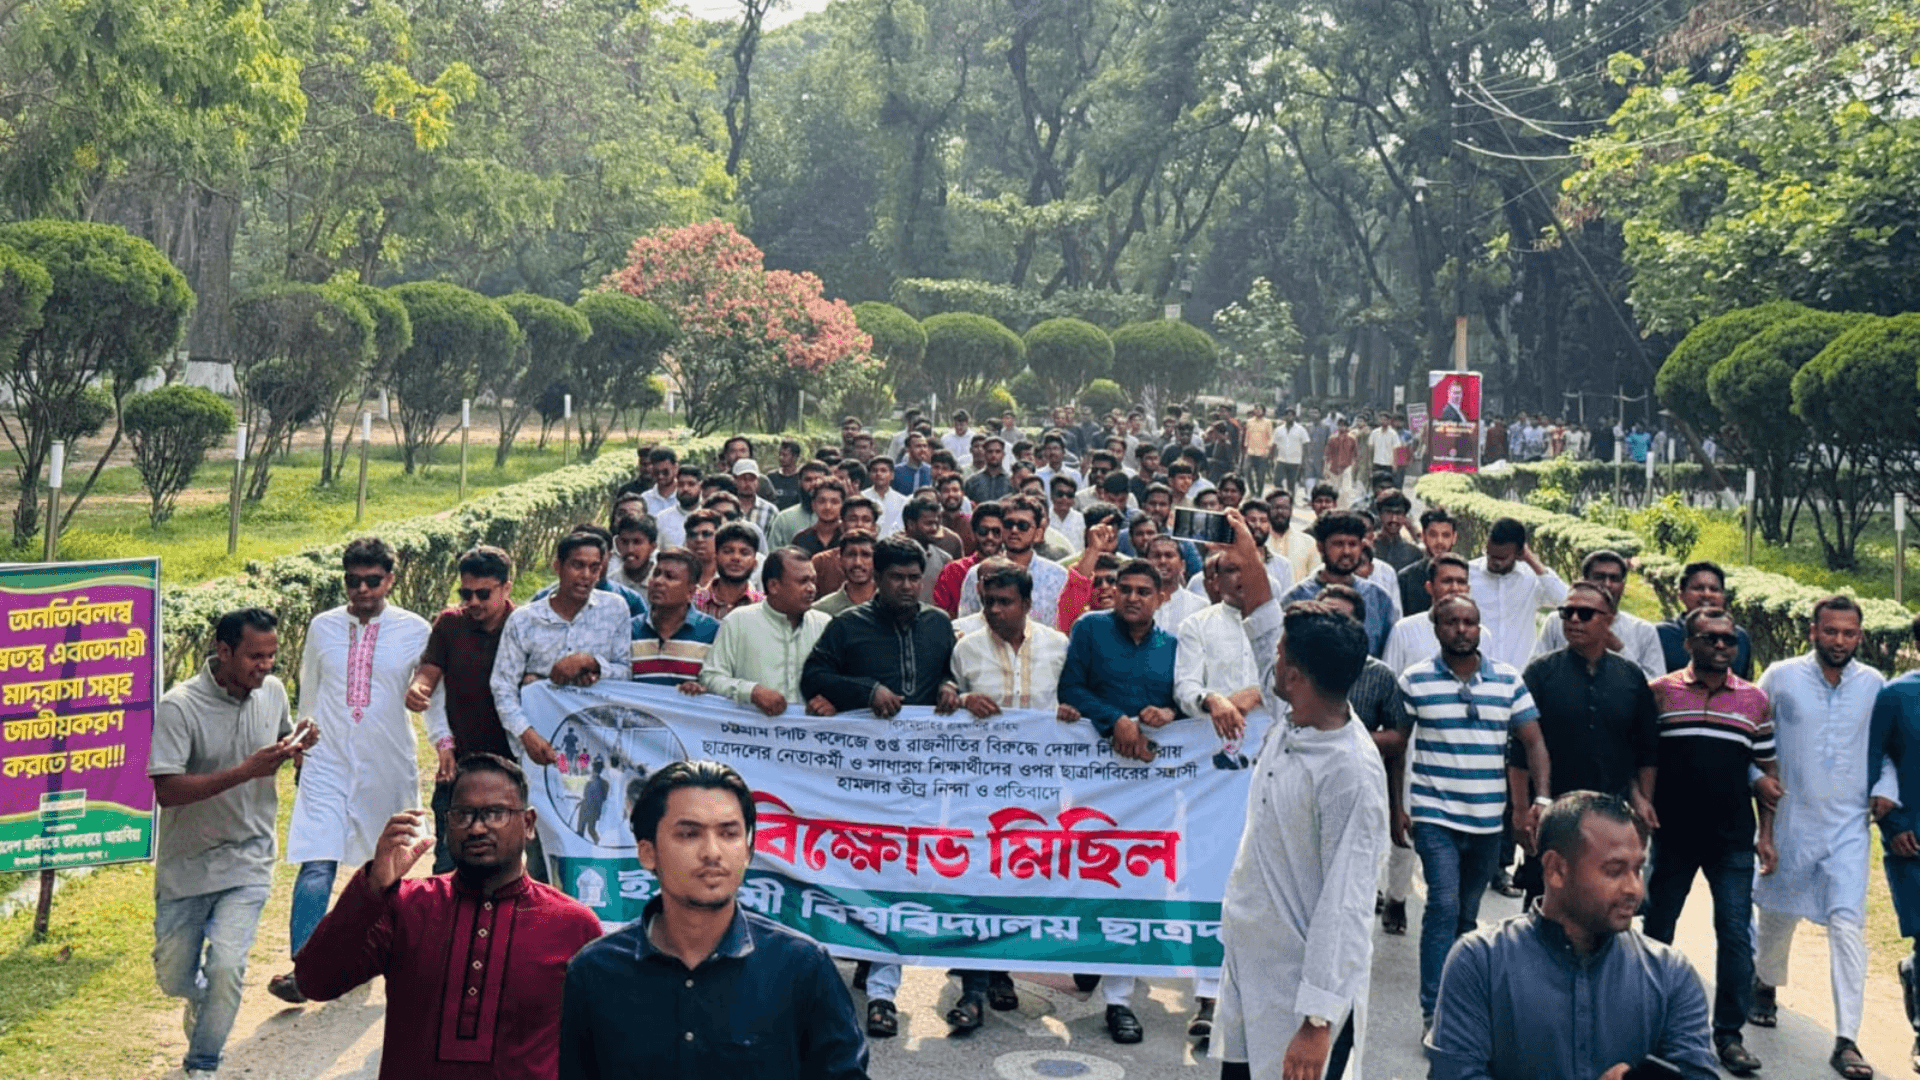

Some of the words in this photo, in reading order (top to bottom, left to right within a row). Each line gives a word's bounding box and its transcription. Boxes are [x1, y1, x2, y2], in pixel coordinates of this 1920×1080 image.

[8, 596, 134, 631] অনতিবিলম্বে
[3, 709, 125, 742] জাতীয়করণ
[774, 726, 806, 741] সিটি
[813, 730, 870, 750] কলেজে
[874, 738, 900, 752] গুপ্ত
[906, 733, 981, 753] রাজনীতির
[986, 735, 1039, 756] বিরুদ্ধে
[1044, 742, 1091, 757] দেয়াল
[2, 752, 68, 779] করতে
[701, 740, 772, 760] ছাত্রদলের
[777, 749, 844, 769] নেতাকর্মী
[850, 759, 862, 770] ও
[868, 758, 924, 774] সাধারণ
[929, 756, 1012, 775] শিক্ষার্থীদের
[1019, 764, 1055, 777] ওপর
[1060, 761, 1151, 781] ছাত্রশিবিরের
[836, 776, 891, 795] হামলার
[897, 777, 927, 797] তীব্র
[933, 778, 970, 797] নিন্দা
[976, 785, 988, 797] ও
[993, 781, 1062, 800] প্রতিবাদে
[986, 806, 1182, 888] মিছিল
[801, 889, 1081, 941] বিশ্ববিদ্যালয়
[1097, 917, 1223, 945] ছাত্রদ
